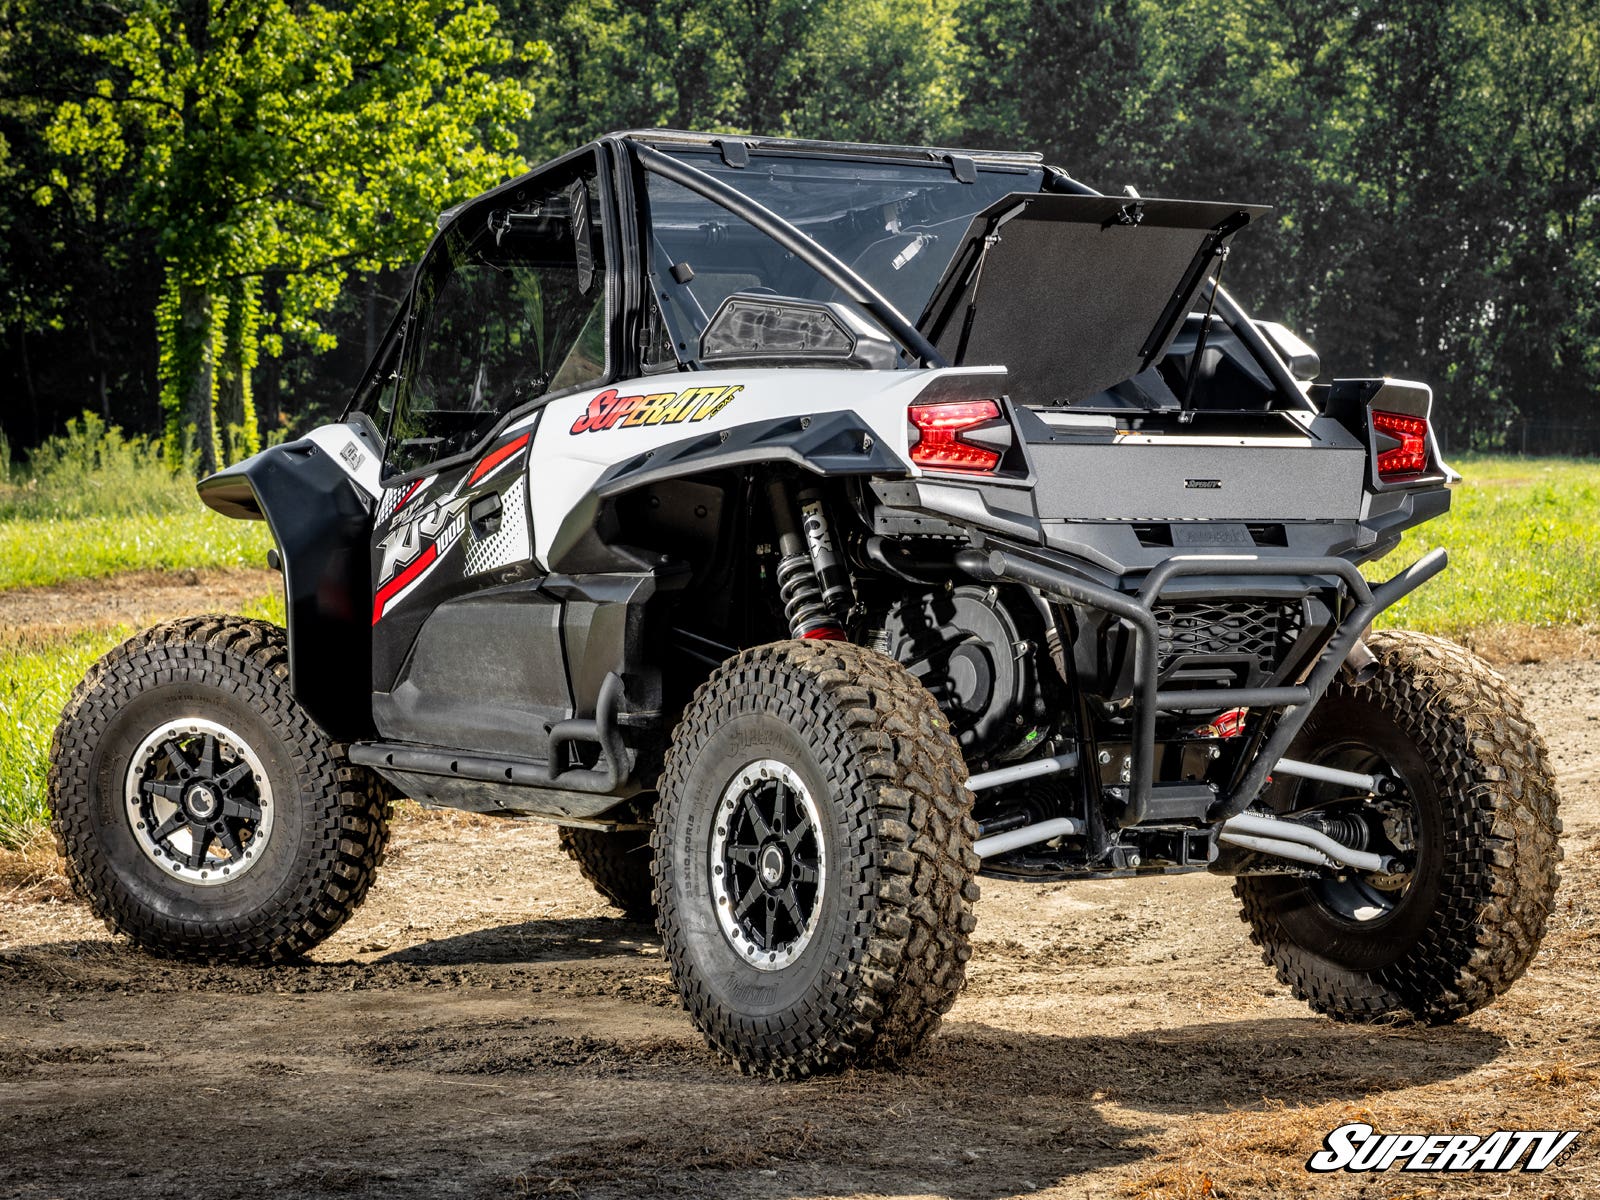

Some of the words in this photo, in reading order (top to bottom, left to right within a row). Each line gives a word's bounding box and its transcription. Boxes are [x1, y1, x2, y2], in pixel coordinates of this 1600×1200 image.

[569, 385, 745, 435] SUPERATV
[435, 511, 466, 556] 1000
[801, 500, 834, 560] FOX
